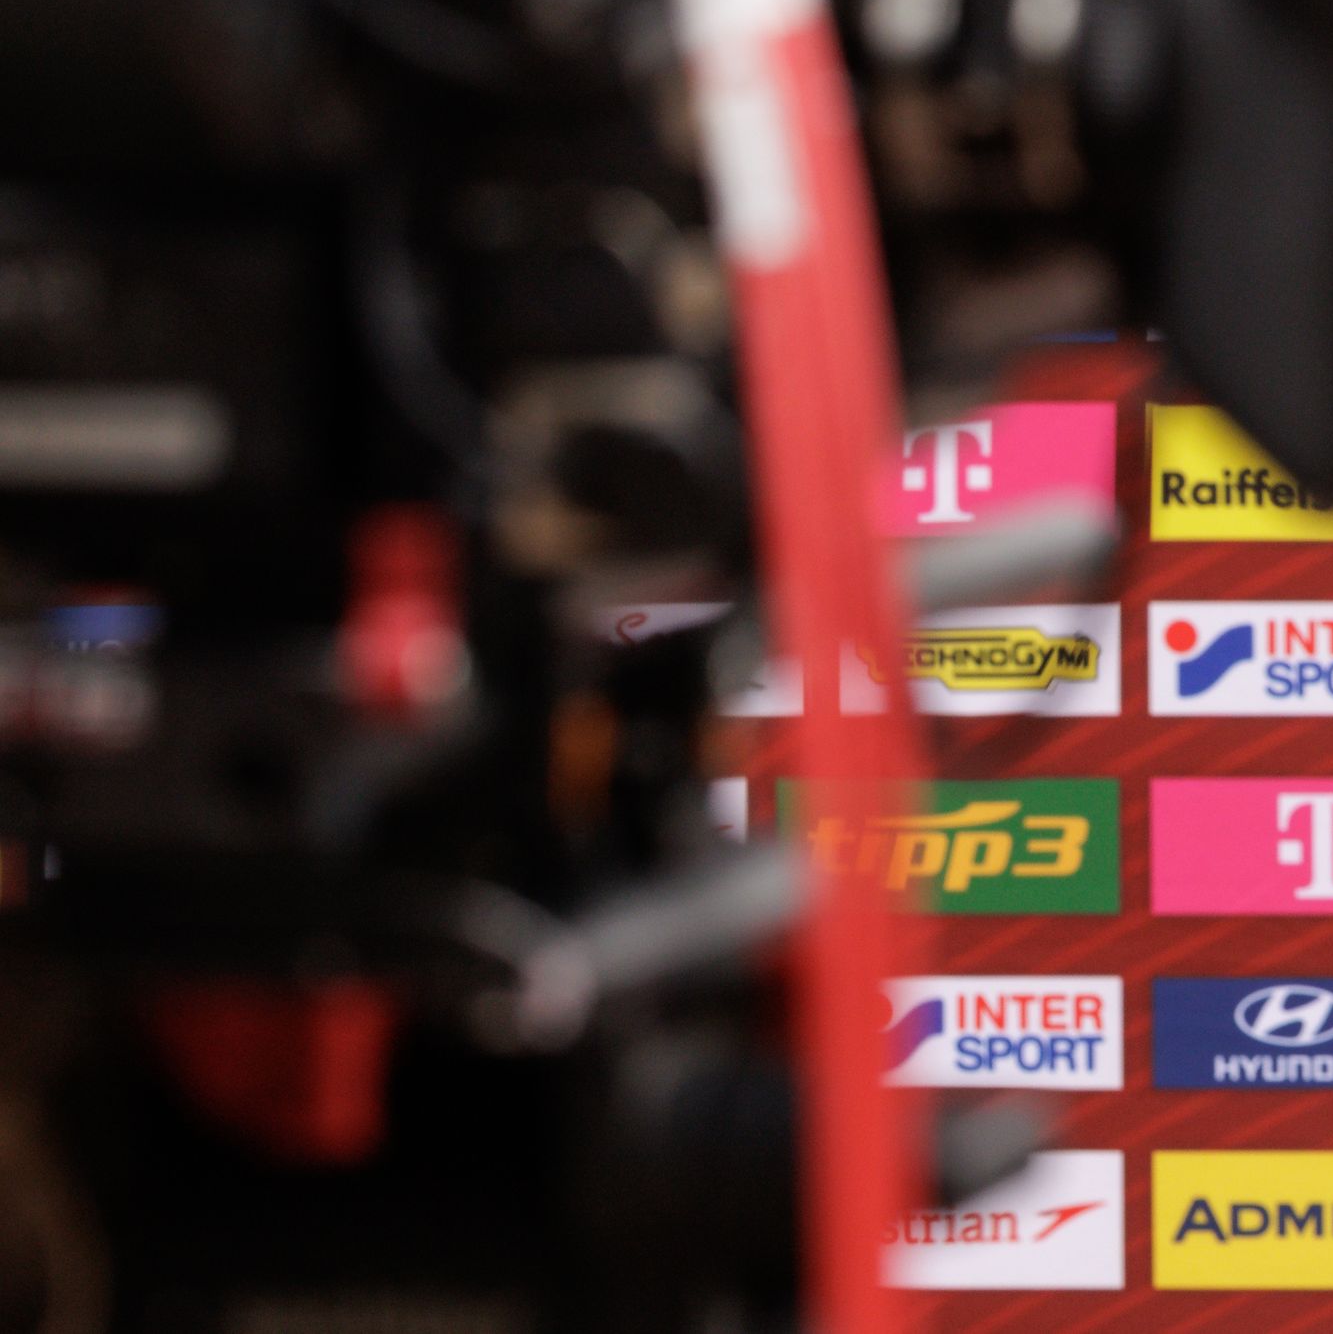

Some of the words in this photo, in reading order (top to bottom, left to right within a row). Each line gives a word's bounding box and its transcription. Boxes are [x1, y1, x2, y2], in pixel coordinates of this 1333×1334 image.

[901, 418, 992, 523] T
[958, 995, 1102, 1030] INTER
[956, 1036, 1102, 1072] SPORT
[879, 1210, 1018, 1245] strian
